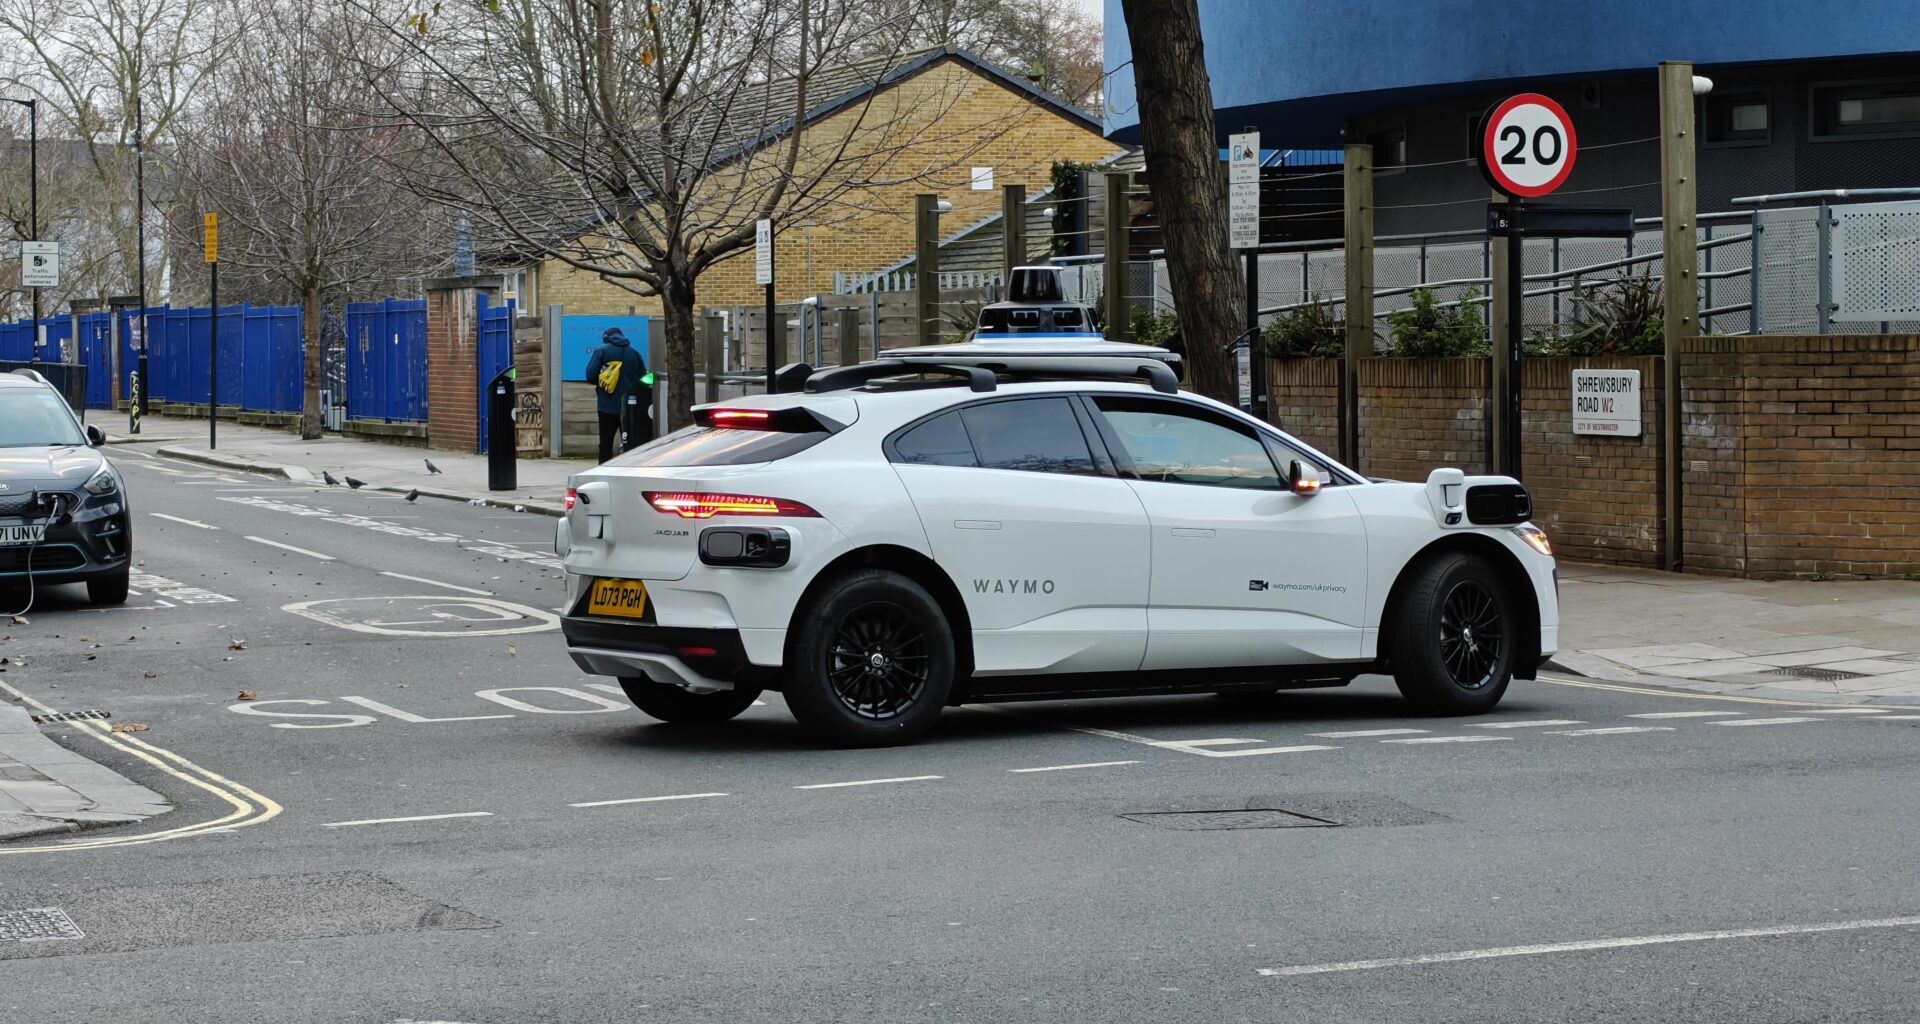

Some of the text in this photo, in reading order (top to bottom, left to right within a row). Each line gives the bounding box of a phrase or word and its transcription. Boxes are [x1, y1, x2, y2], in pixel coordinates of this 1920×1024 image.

[1500, 125, 1562, 165] 20
[1577, 376, 1633, 393] SHREWSBURY
[1577, 396, 1614, 413] ROAD W2
[1577, 422, 1586, 431] CITY
[1592, 423, 1619, 432] WESTMINSTER
[12, 526, 39, 540] UNV
[973, 578, 1055, 594] WAYMO
[1272, 583, 1347, 594] waymo.com/ukprivacy
[594, 586, 642, 609] LD73 PGH
